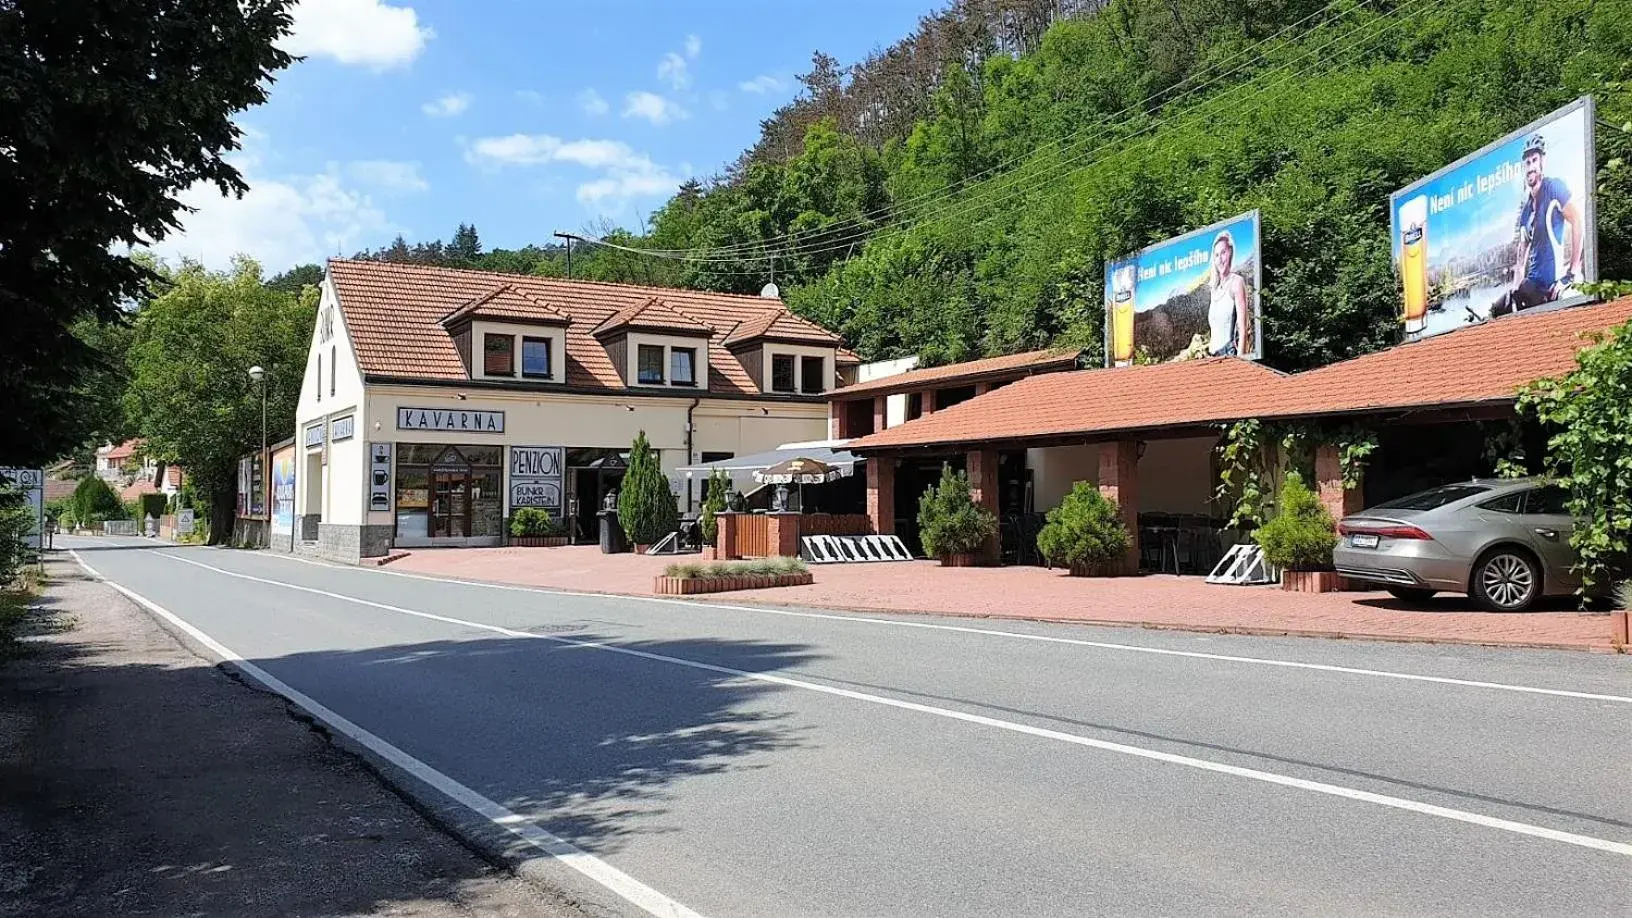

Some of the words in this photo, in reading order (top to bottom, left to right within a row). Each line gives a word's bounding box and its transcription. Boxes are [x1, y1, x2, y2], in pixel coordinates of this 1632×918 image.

[1458, 180, 1474, 204] nic
[405, 410, 496, 430] KAVARNA
[512, 450, 560, 474] PENZION
[516, 486, 544, 496] BUNKR
